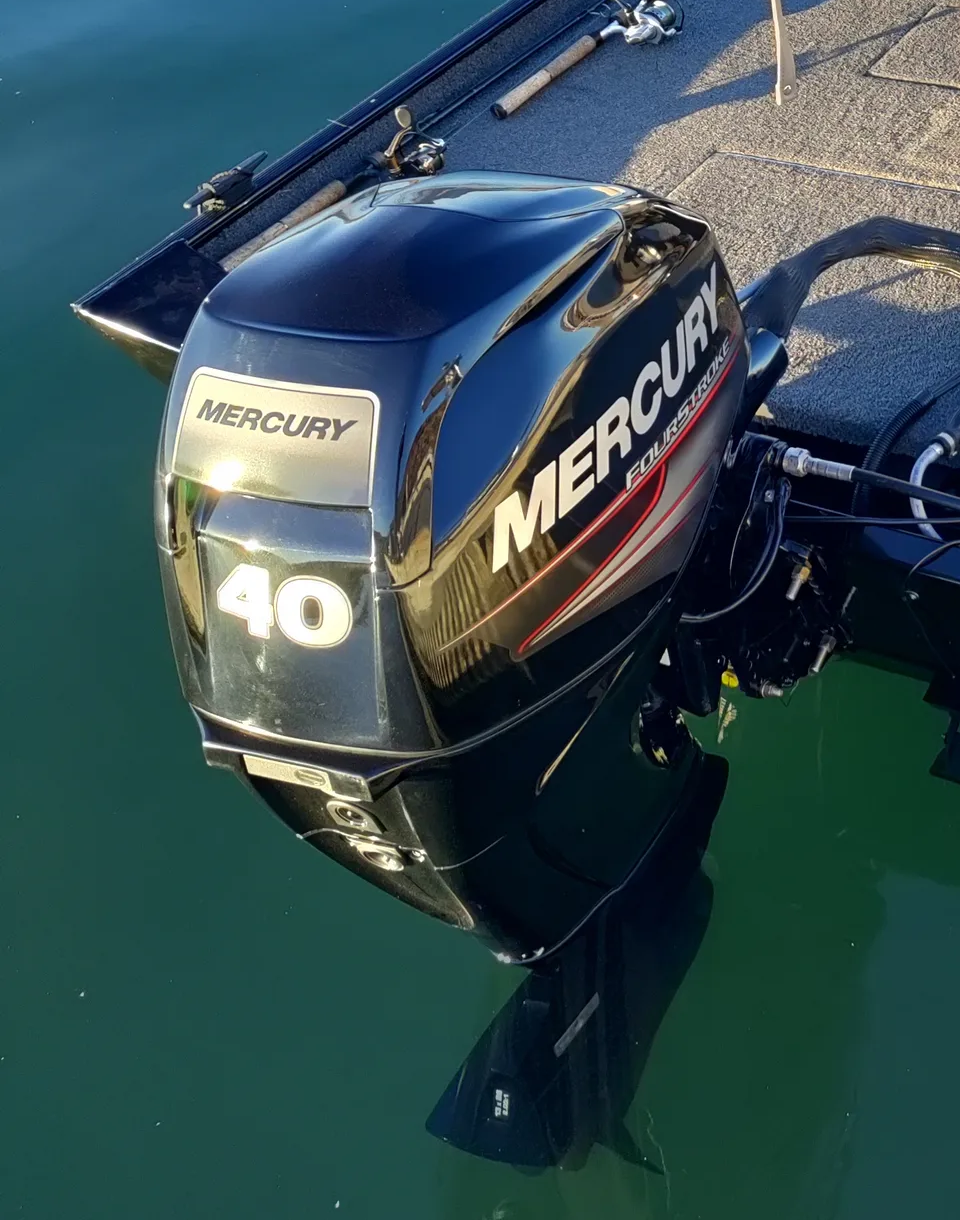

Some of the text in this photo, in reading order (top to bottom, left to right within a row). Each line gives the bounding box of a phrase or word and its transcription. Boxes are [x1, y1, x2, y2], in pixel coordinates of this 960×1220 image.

[196, 399, 358, 441] MERCURY
[493, 261, 719, 574] MERCURY
[625, 336, 730, 491] FOURSTROKE
[217, 563, 353, 648] 40
